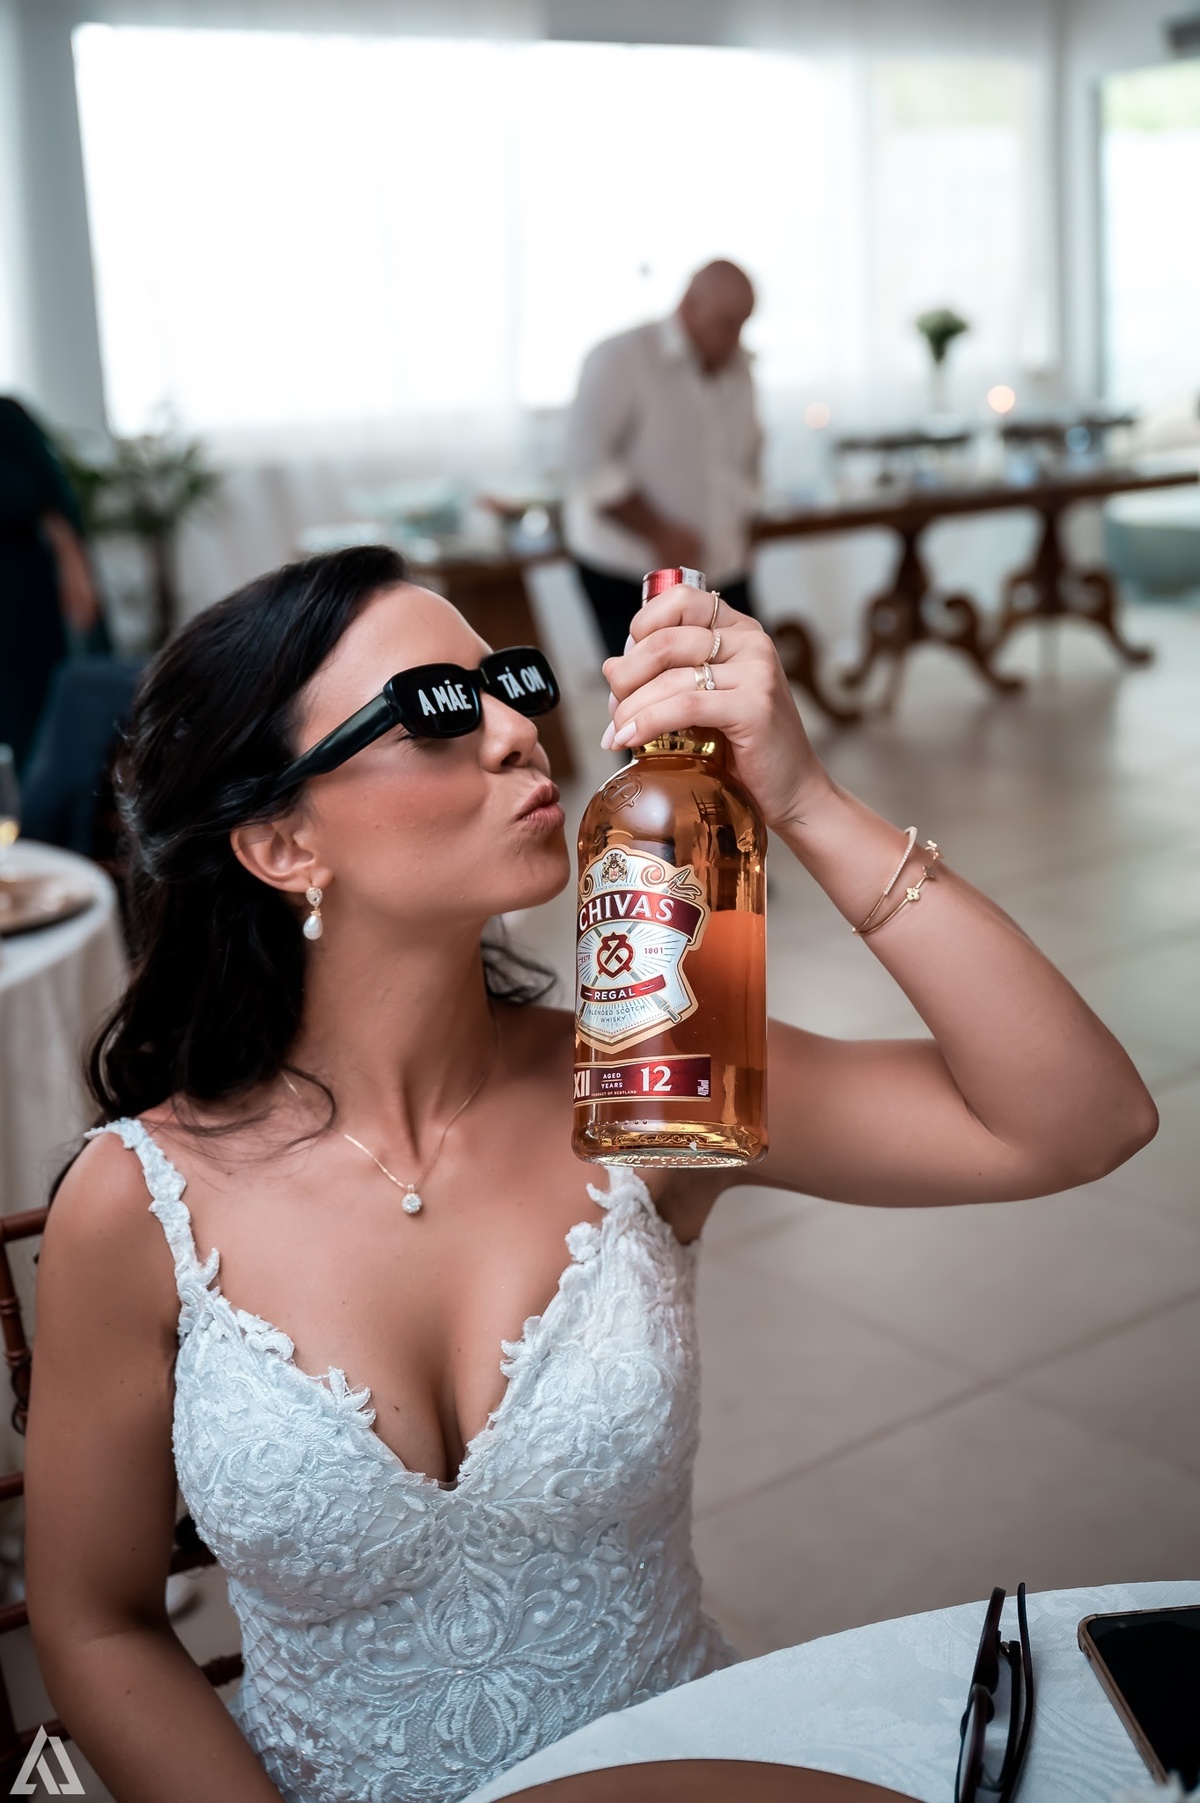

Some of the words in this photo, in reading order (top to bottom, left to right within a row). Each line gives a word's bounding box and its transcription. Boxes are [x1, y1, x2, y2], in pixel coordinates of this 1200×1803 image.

[418, 689, 436, 716] A
[432, 680, 472, 712] MÃE
[497, 667, 526, 699] TÁ
[519, 665, 546, 693] ON
[579, 893, 675, 931] CHIVAS
[594, 988, 636, 1000] REGAL
[616, 1005, 646, 1015] SCOTCH
[641, 1065, 672, 1092] 12
